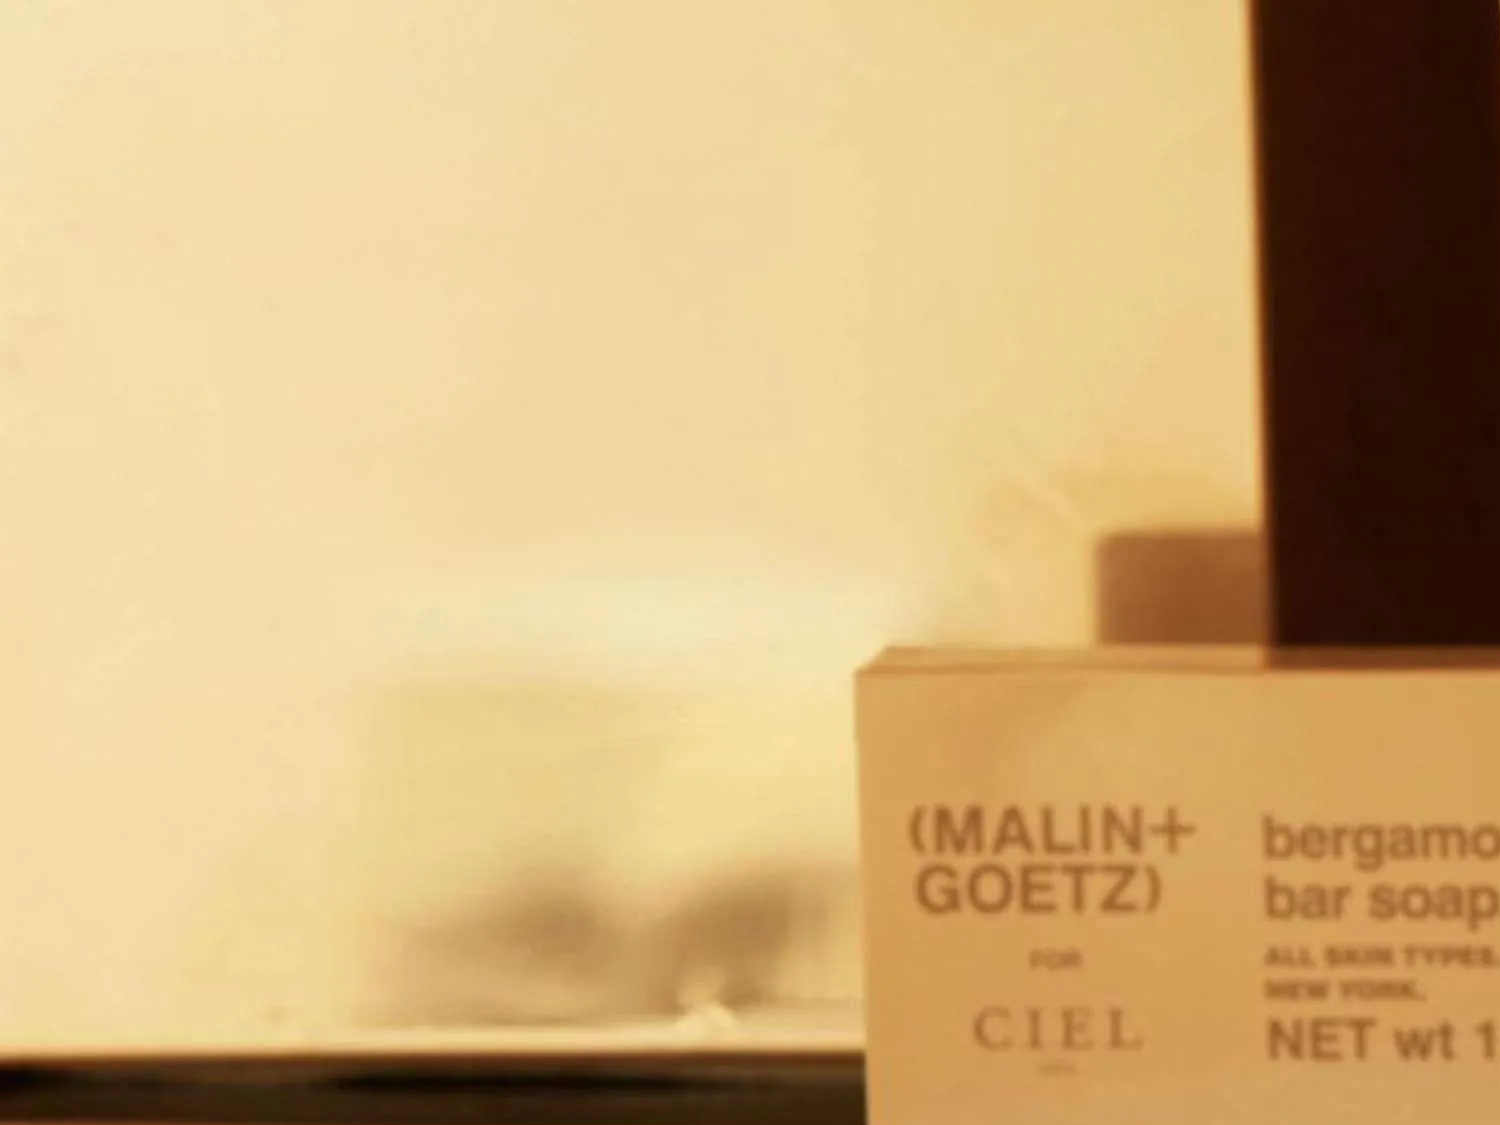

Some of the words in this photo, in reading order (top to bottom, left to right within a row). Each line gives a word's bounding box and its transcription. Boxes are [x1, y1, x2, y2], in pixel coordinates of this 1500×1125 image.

[908, 804, 1196, 856] (MALIN+
[914, 864, 1161, 915] GOETZ)
[1264, 875, 1352, 921] bar
[1029, 949, 1083, 971] FOR
[1264, 946, 1316, 969] ALL
[1324, 945, 1395, 969] SKIN
[1401, 944, 1500, 969] TYPES.
[1264, 980, 1326, 1001] NEW
[1339, 979, 1426, 1001] YORK.
[973, 1007, 1143, 1051] CIEL
[1267, 1017, 1377, 1062] NET
[1393, 1020, 1455, 1061] wt
